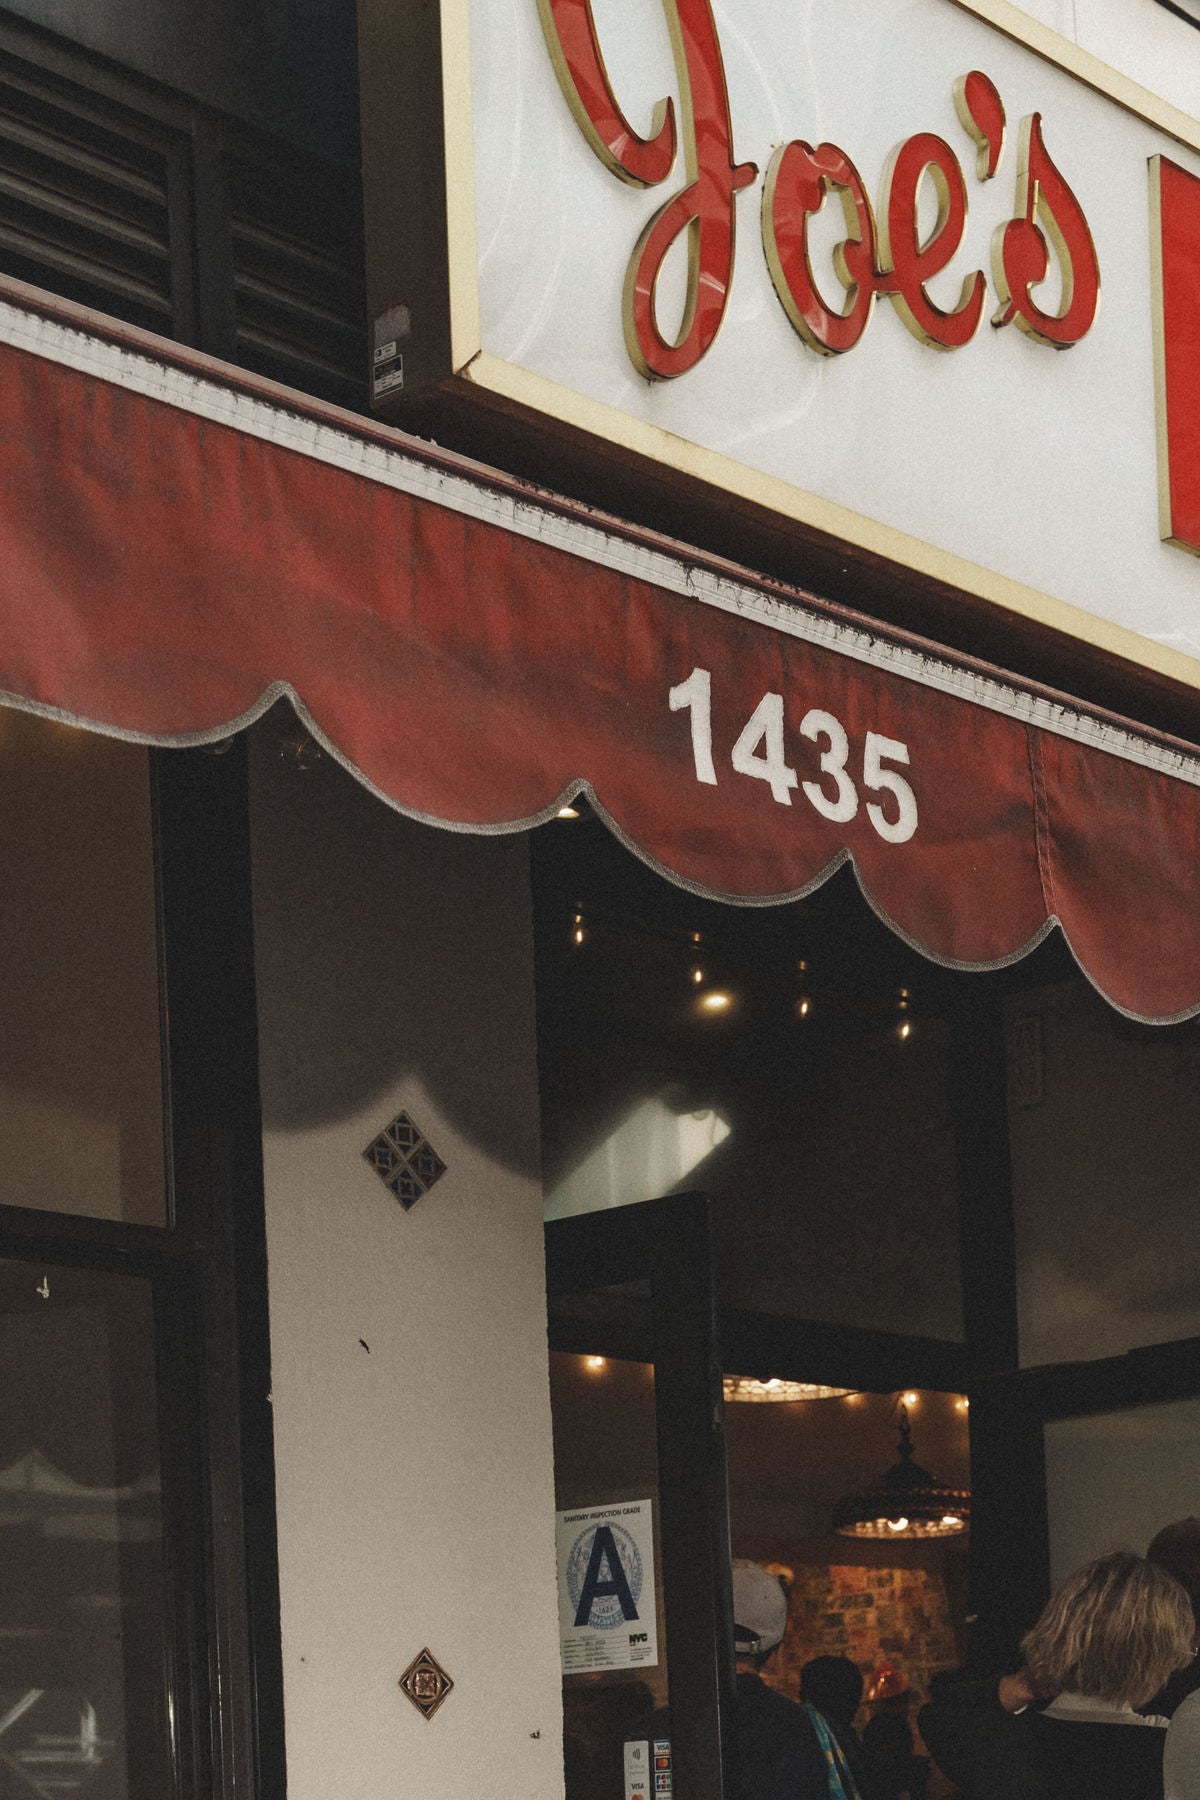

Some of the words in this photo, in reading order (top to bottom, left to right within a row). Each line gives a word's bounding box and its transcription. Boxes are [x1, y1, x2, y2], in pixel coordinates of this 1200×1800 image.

[536, 0, 1100, 382] Joe's
[669, 667, 918, 843] 1435
[563, 1513, 589, 1523] SANITARY
[590, 1508, 621, 1520] INSPECTION
[622, 1505, 641, 1515] GRADE
[574, 1526, 639, 1627] A
[629, 1633, 648, 1643] NYC
